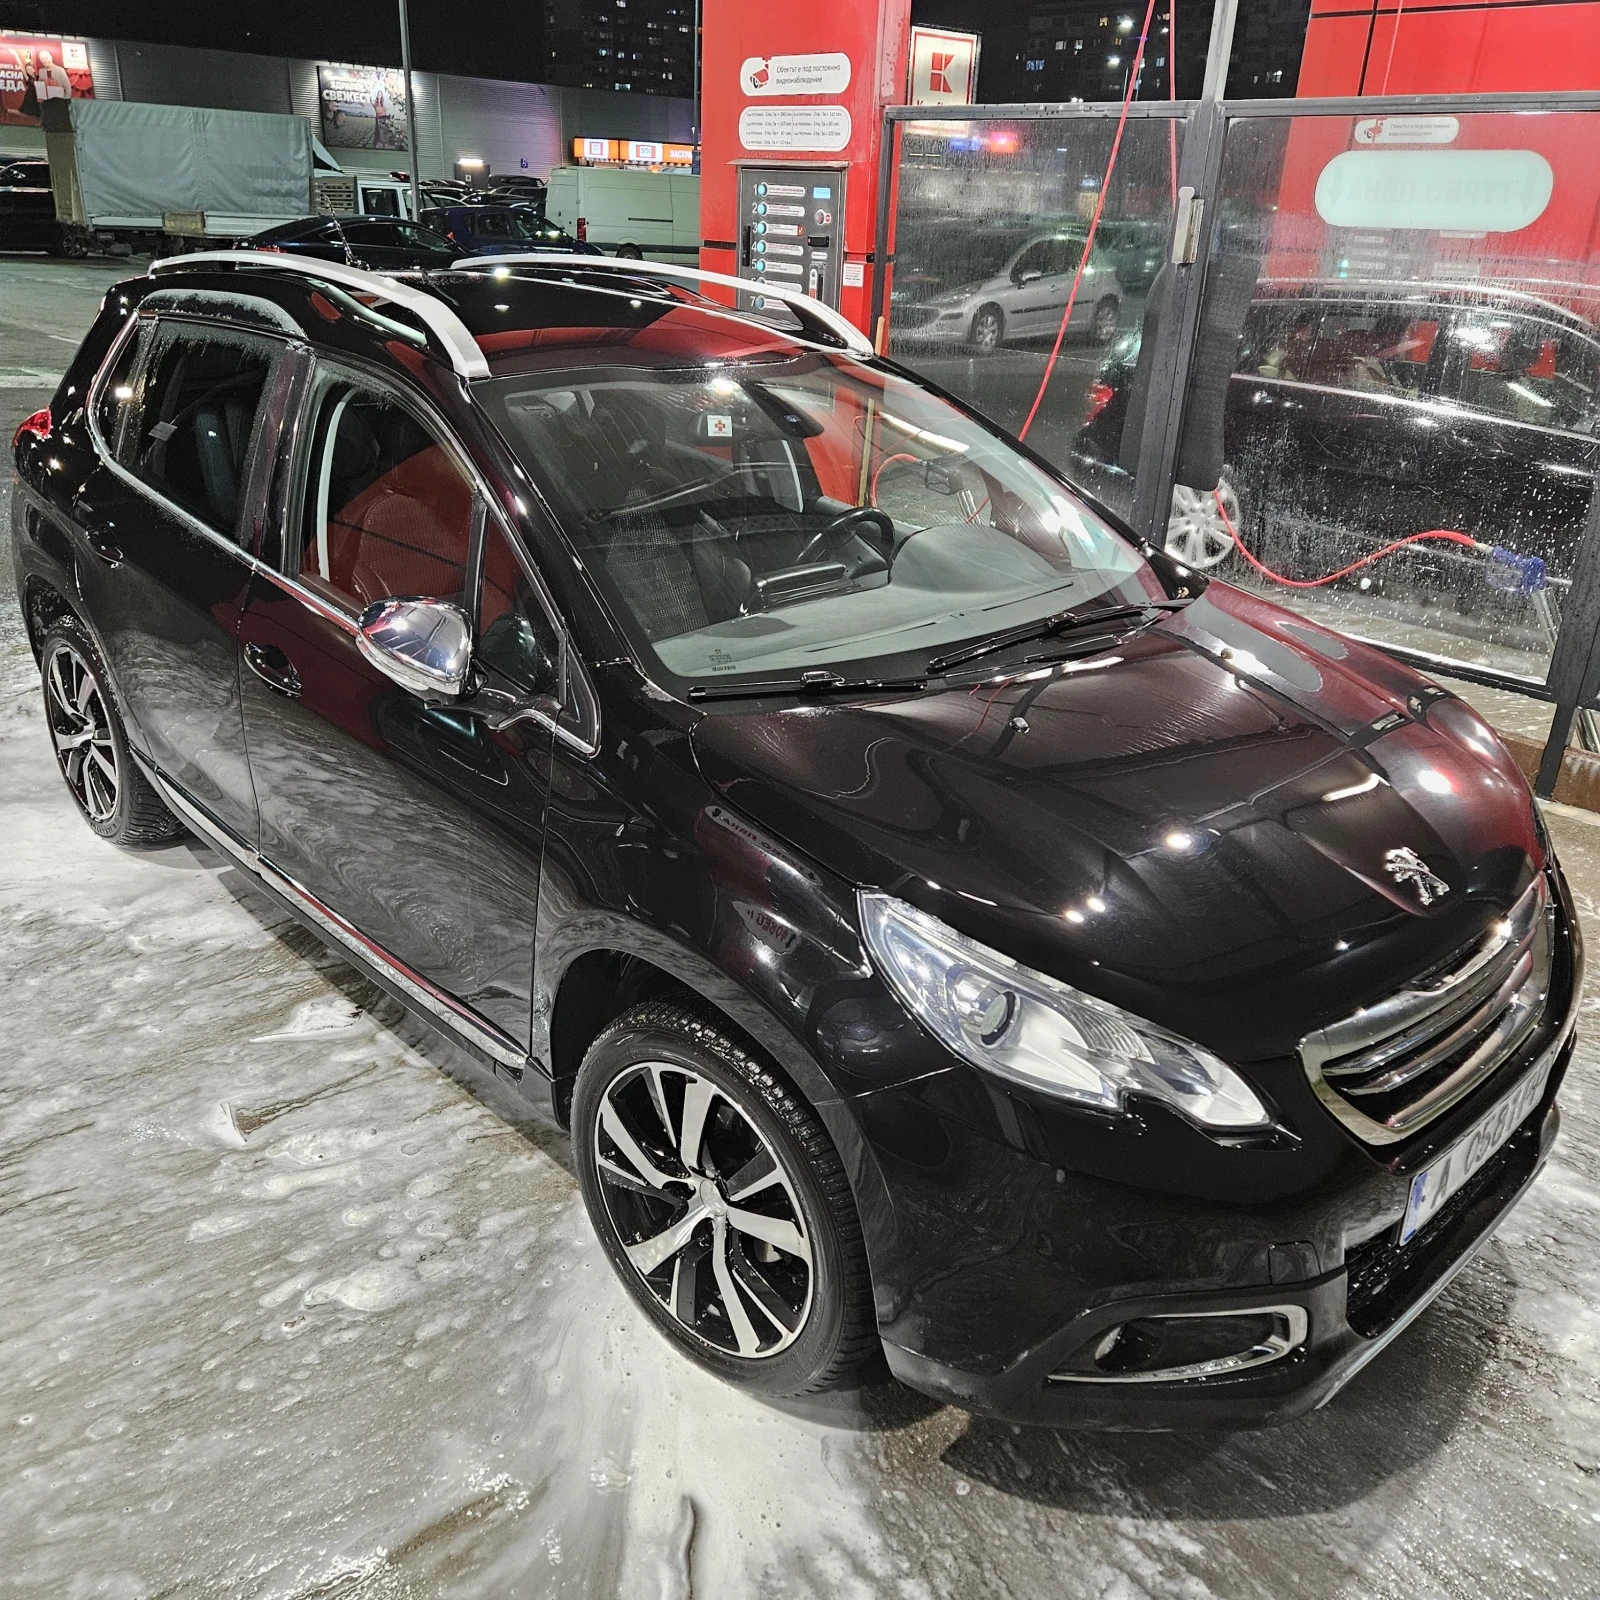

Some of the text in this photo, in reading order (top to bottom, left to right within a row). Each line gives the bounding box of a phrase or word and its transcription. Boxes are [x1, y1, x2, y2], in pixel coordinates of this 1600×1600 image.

[776, 65, 797, 73] Обектът
[802, 65, 812, 73] под
[813, 64, 841, 72] постоянно
[776, 76, 822, 85] видеонаблюдение
[752, 203, 758, 214] 2
[752, 222, 758, 233] 3
[751, 241, 757, 252] 4
[751, 259, 757, 269] 5
[750, 296, 755, 306] 7
